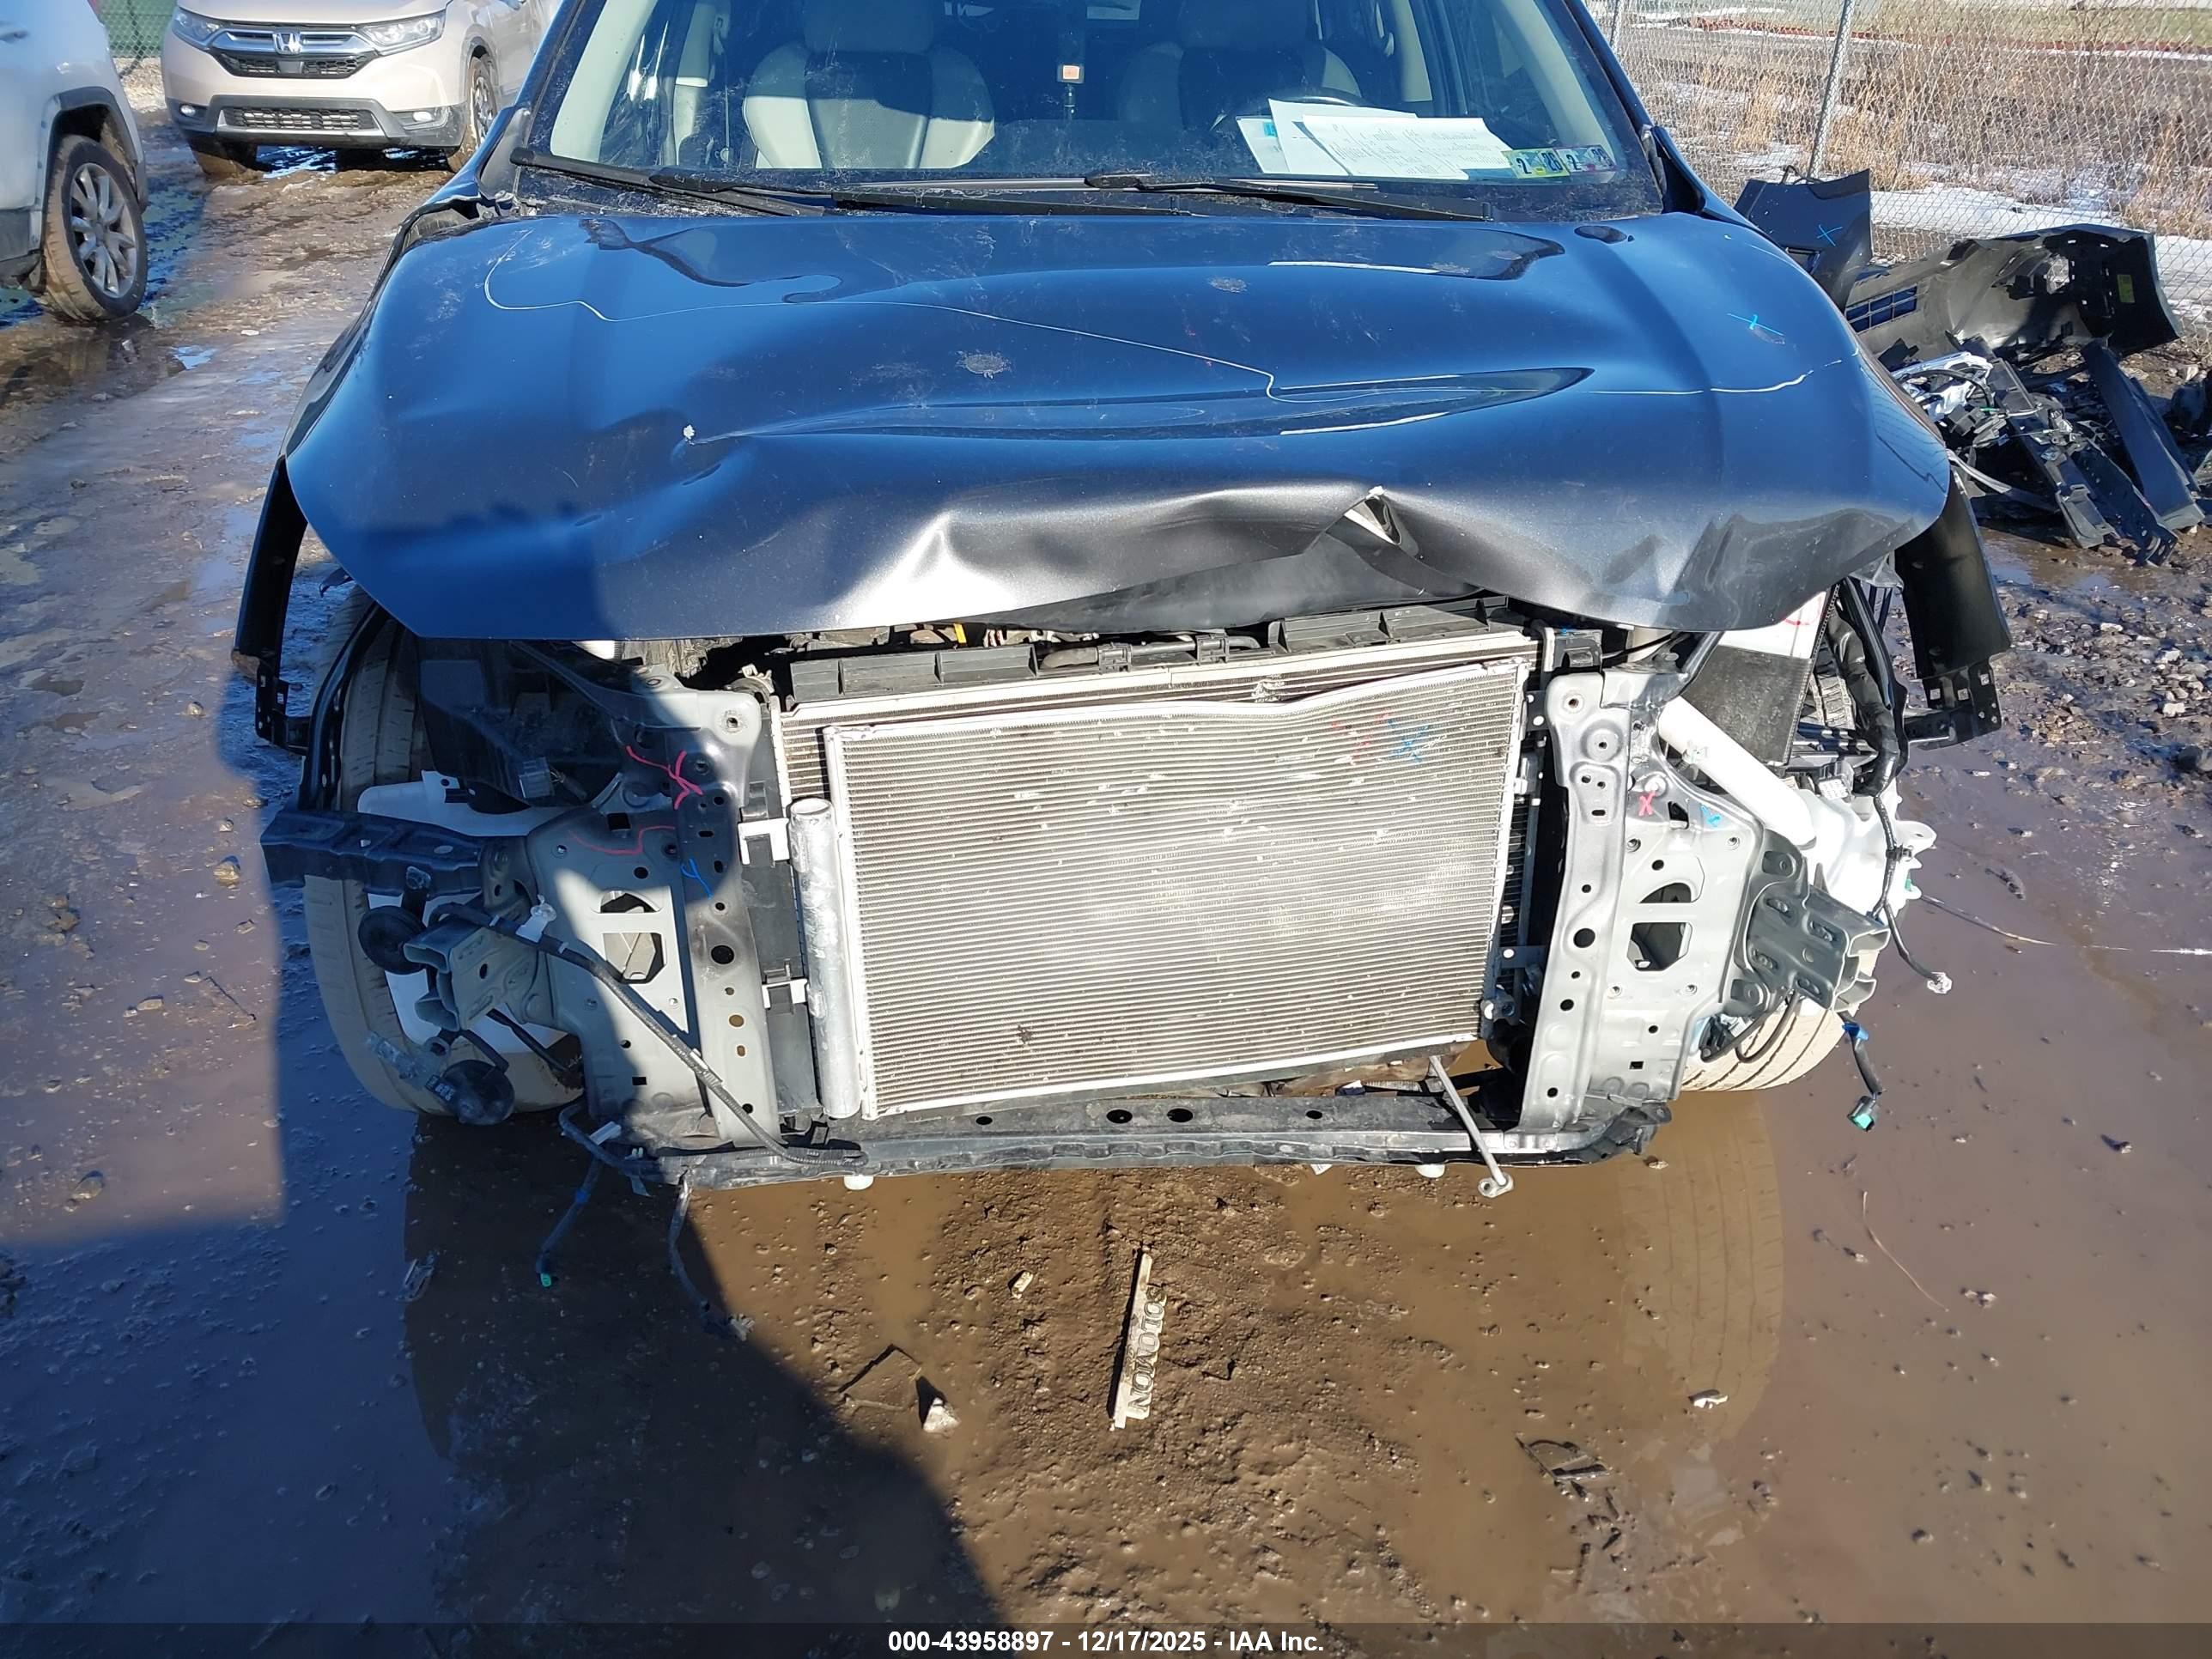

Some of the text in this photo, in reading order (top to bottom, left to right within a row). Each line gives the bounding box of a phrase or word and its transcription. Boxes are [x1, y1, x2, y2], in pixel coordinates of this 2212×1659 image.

[1516, 152, 1564, 174] 2 26
[1128, 1286, 1166, 1412] SOLOMON
